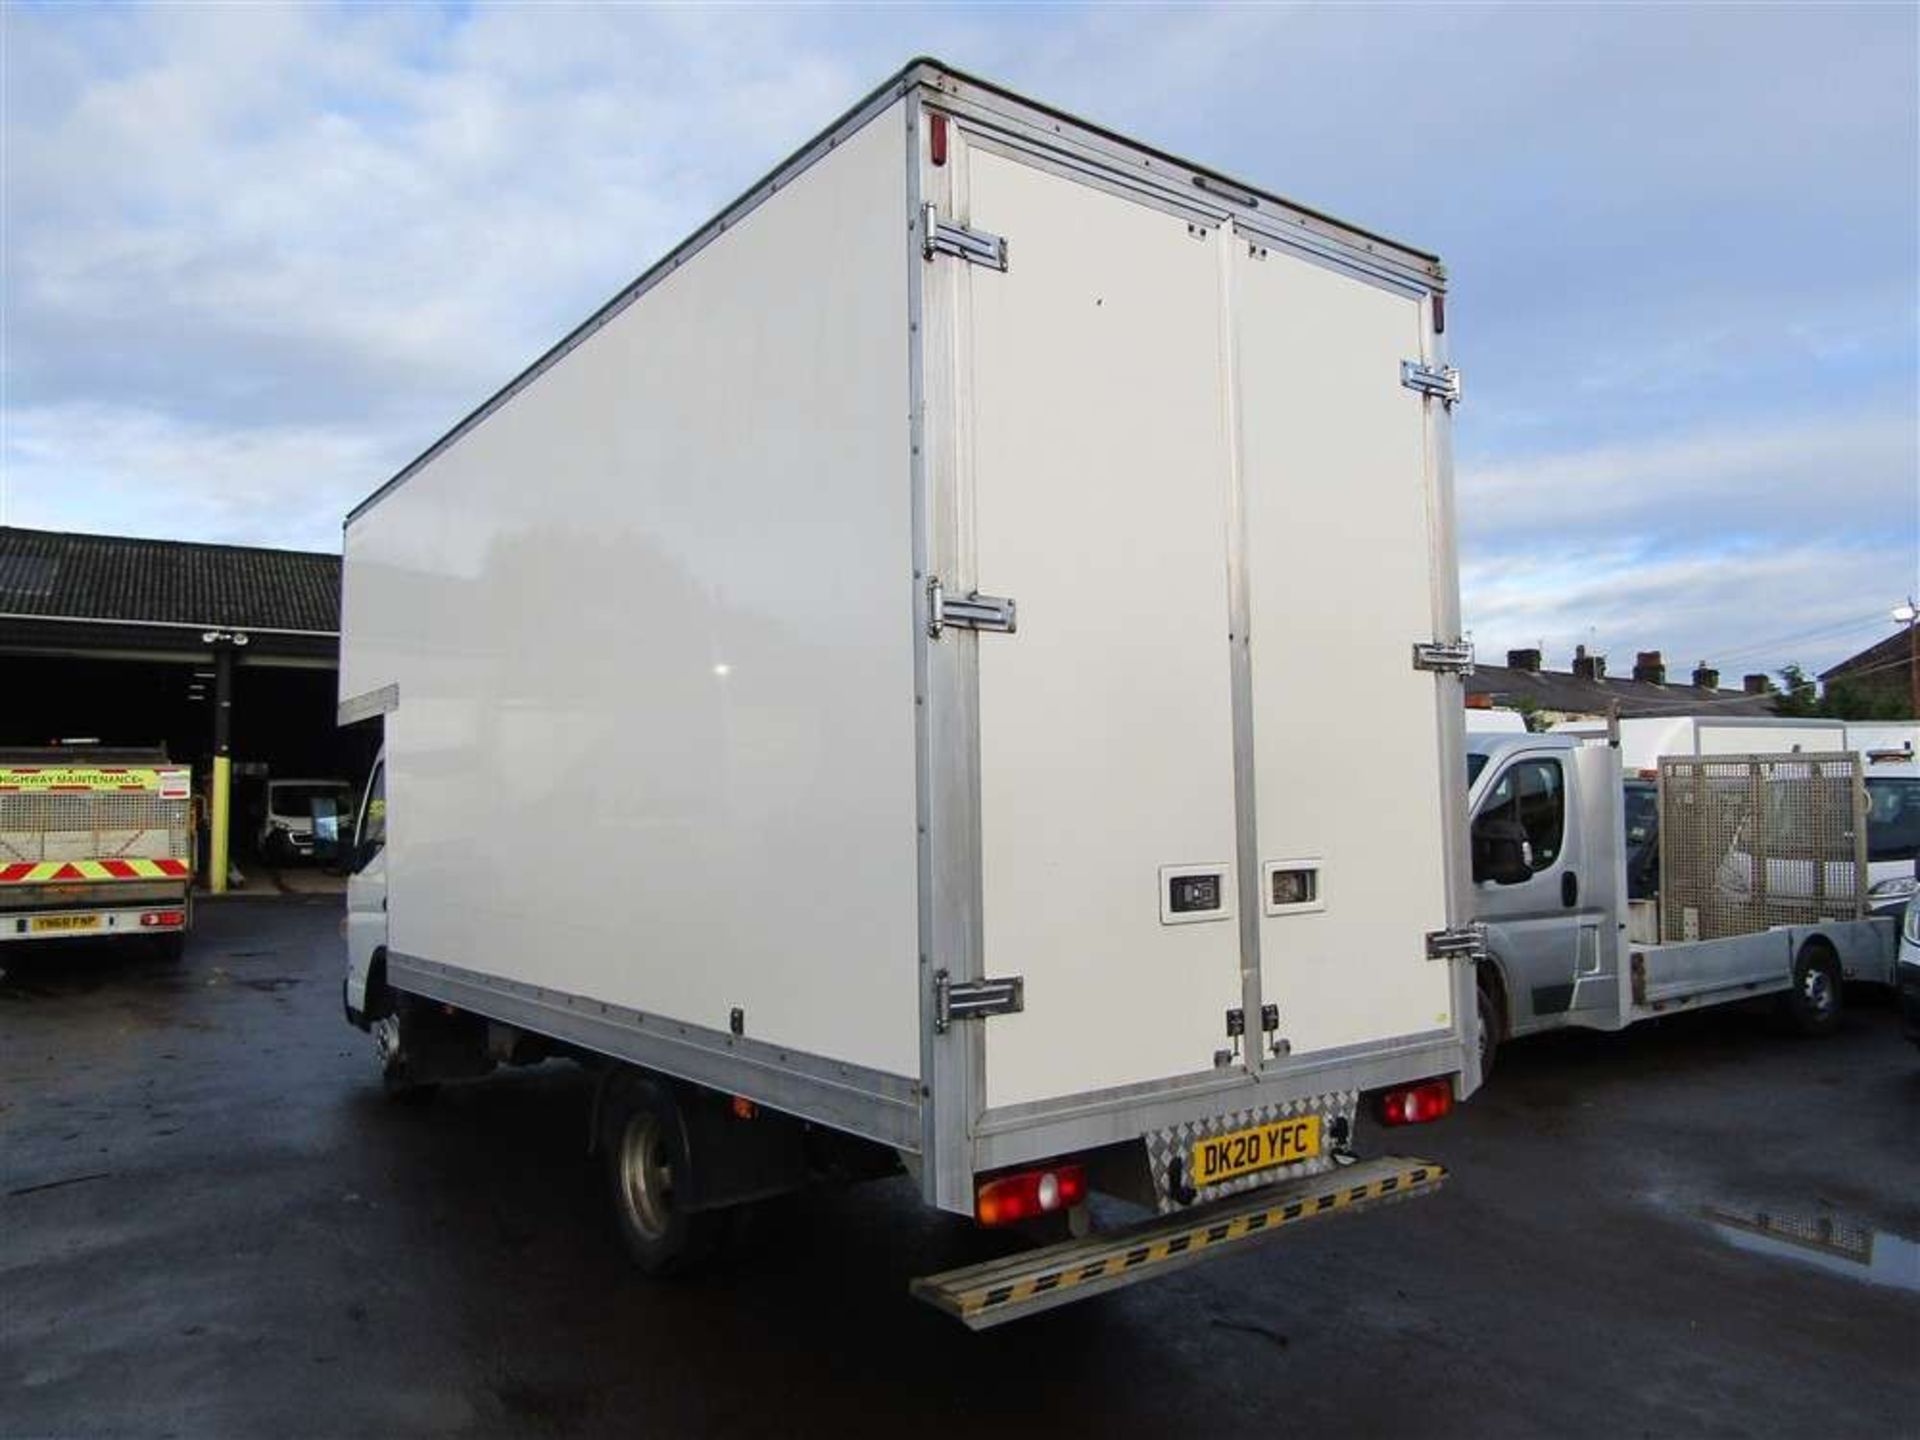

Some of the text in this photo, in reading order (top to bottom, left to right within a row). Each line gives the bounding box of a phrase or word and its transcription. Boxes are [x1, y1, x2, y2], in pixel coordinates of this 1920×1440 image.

[0, 774, 138, 785] HIGHWAY MAINTENANCE
[1204, 1123, 1308, 1176] DK20 YFC
